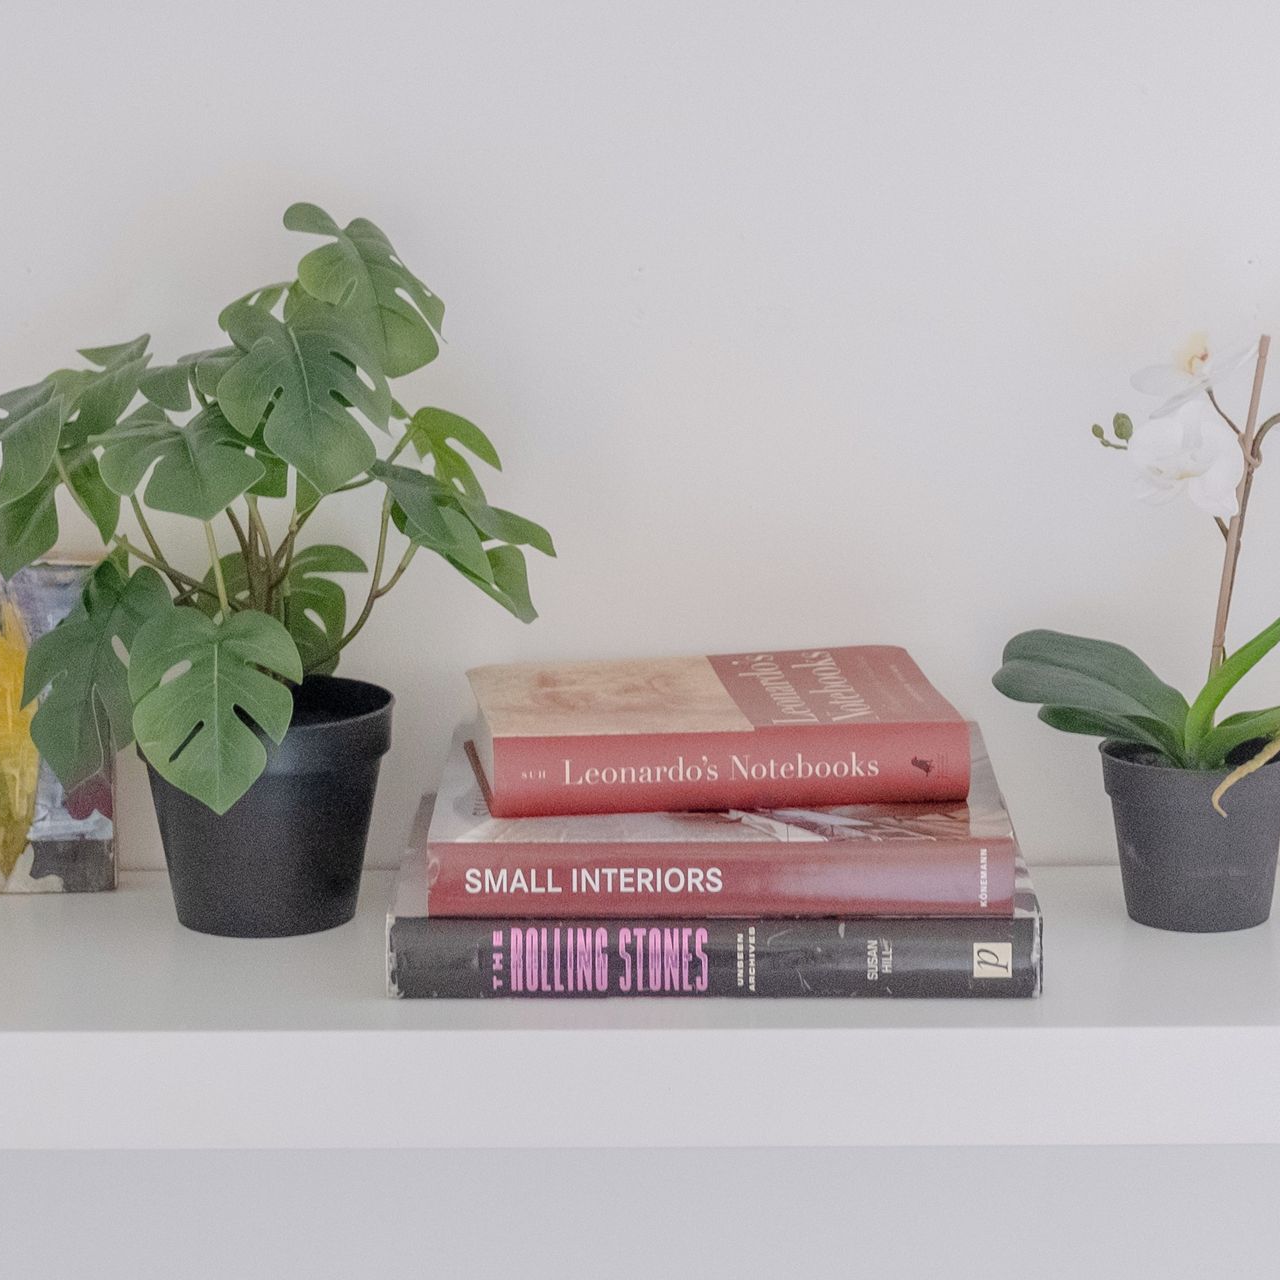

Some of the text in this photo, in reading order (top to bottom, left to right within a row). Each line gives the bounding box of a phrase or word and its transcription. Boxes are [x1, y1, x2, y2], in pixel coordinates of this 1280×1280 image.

[729, 751, 880, 782] Notebooks
[464, 867, 724, 894] SMALL INTERIORS
[492, 927, 710, 992] THE ROLLING STONES
[736, 933, 744, 987] UNSEEN
[748, 926, 756, 992] ARCHIVES
[866, 939, 879, 981] SUSAN
